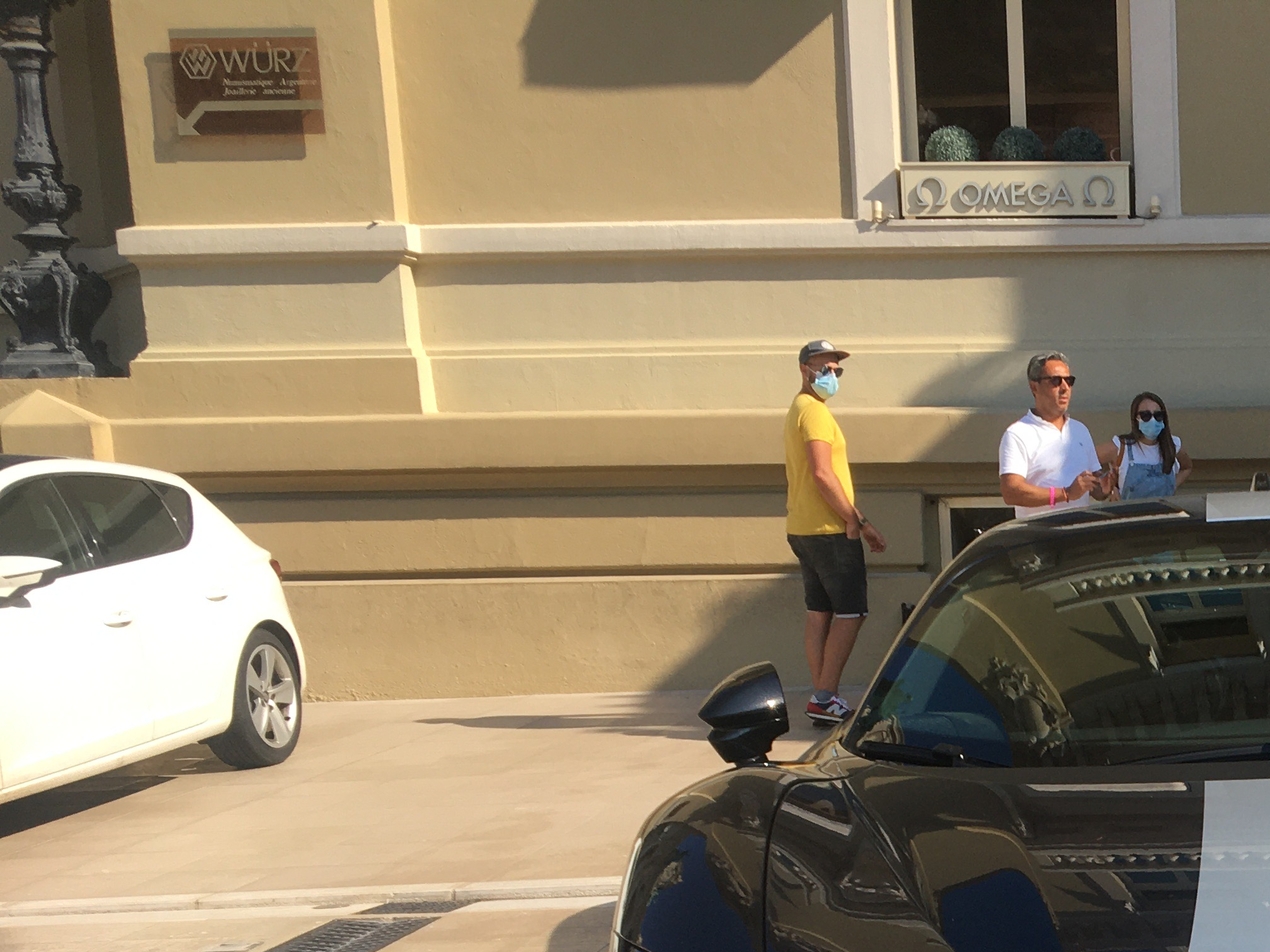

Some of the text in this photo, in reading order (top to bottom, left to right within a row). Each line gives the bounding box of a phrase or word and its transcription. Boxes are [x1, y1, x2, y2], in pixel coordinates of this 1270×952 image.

[218, 41, 311, 74] WÜRZ
[222, 77, 274, 88] Numismatique
[958, 181, 1074, 207] OMEGA
